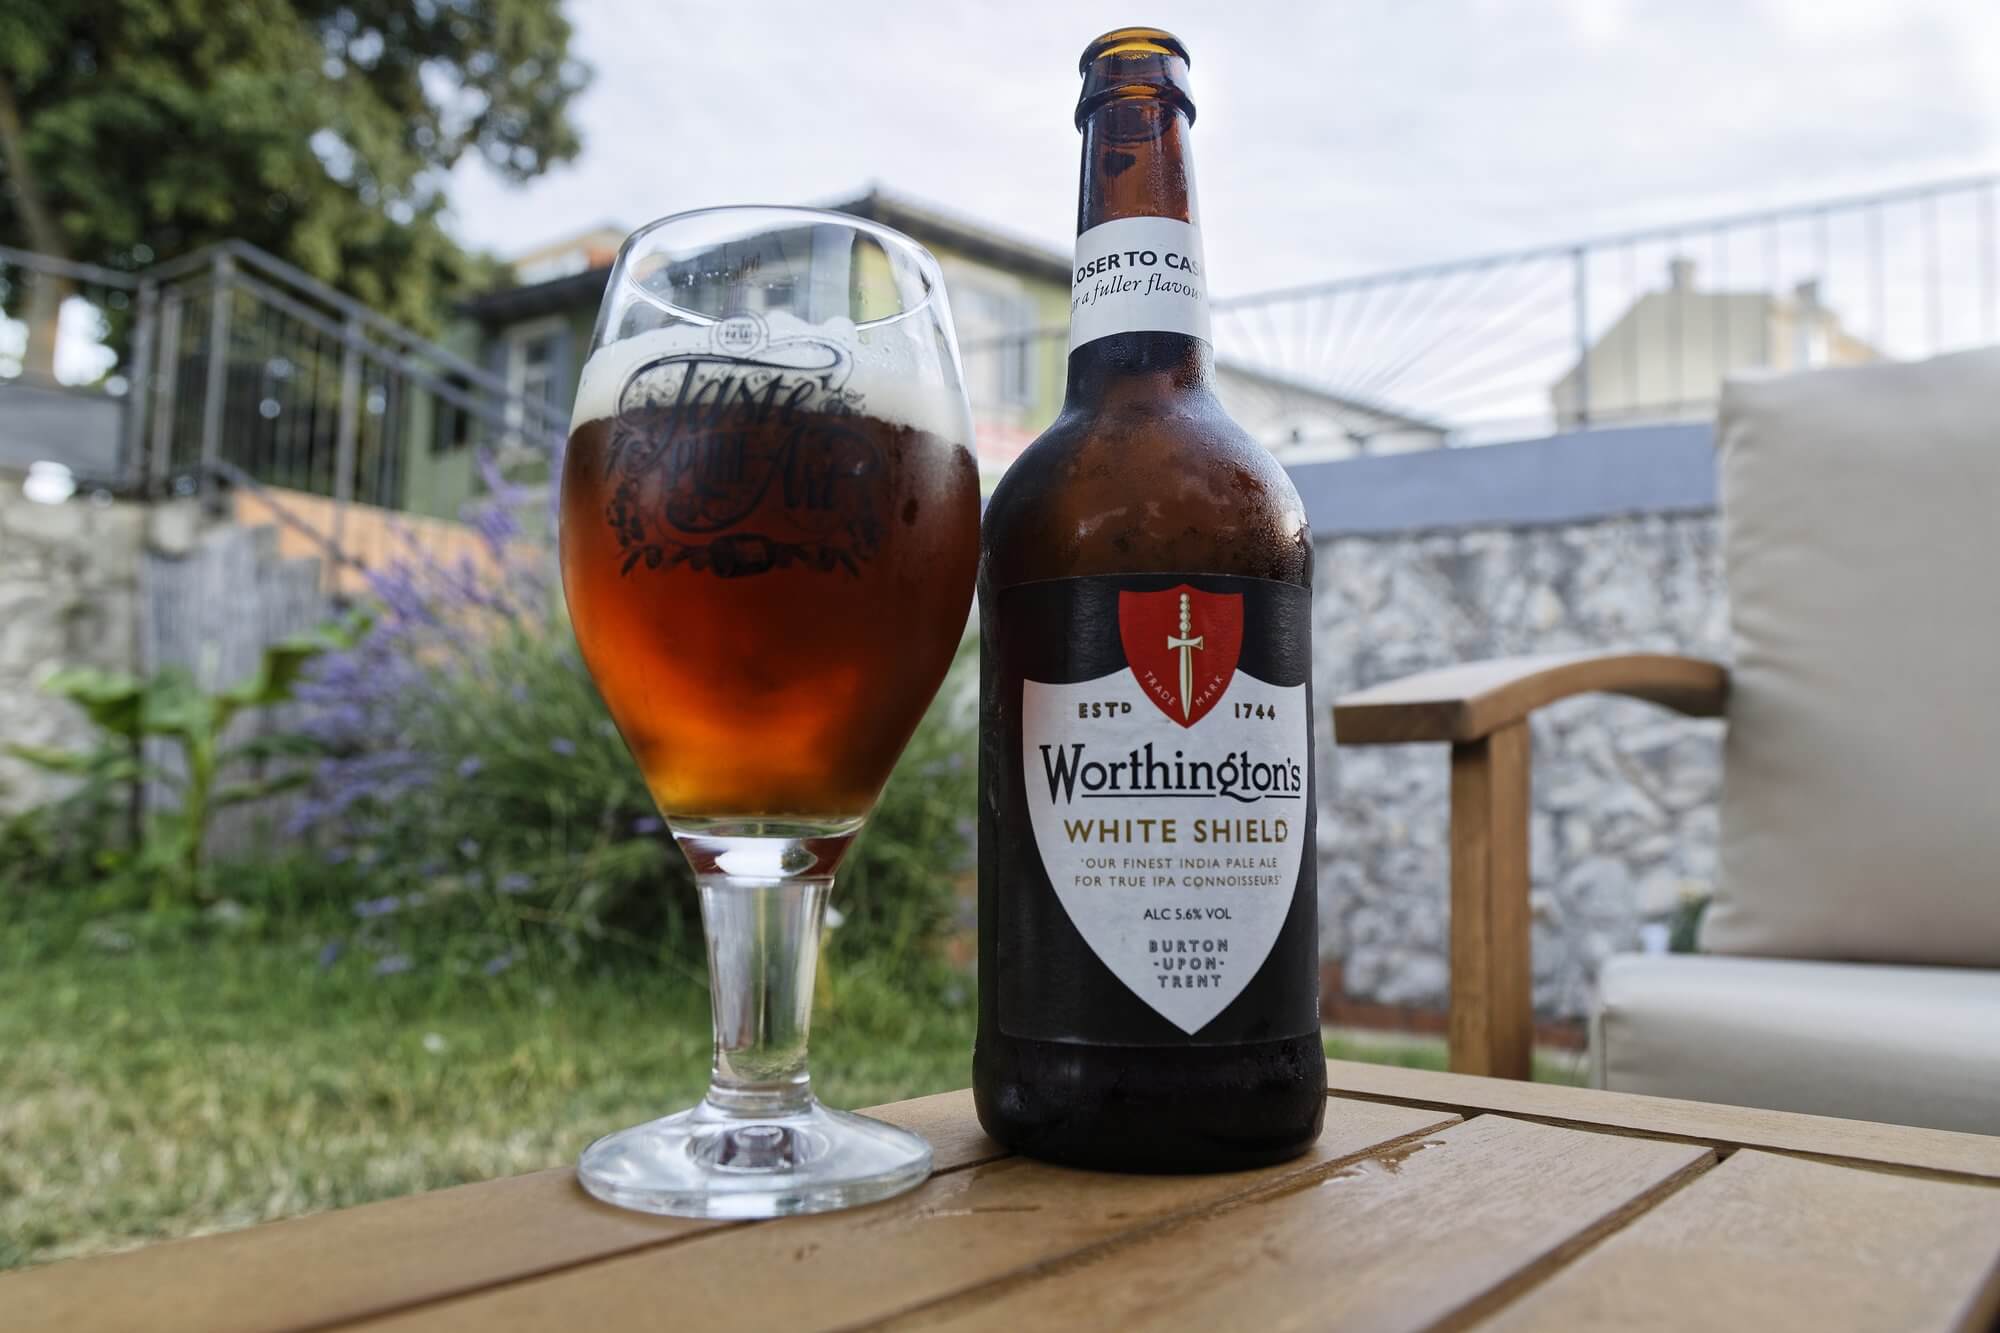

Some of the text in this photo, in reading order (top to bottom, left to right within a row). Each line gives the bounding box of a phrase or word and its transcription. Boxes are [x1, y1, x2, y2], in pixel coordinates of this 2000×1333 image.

[1074, 253, 1120, 288] OSER
[1124, 250, 1157, 267] TO
[1081, 291, 1090, 305] a
[1091, 275, 1142, 306] fuller
[1144, 272, 1202, 300] flavou
[1144, 670, 1177, 706] TRADE
[1195, 674, 1223, 707] MARK
[1078, 702, 1276, 720] ESTD 1744
[1039, 742, 1301, 805] Worthington's
[1063, 818, 1288, 843] WHITE SHIELD
[1123, 857, 1173, 869] FINEST
[1179, 857, 1220, 869] INDIA
[1226, 857, 1255, 869] PALE
[1259, 857, 1278, 869] ALE
[1074, 875, 1102, 887] FOR
[1109, 875, 1146, 887] TRUE
[1152, 875, 1176, 887] IPA
[1143, 907, 1232, 920] ALC 5.6% VOL
[1148, 939, 1229, 953] BURTON
[1157, 974, 1222, 988] TRENT
